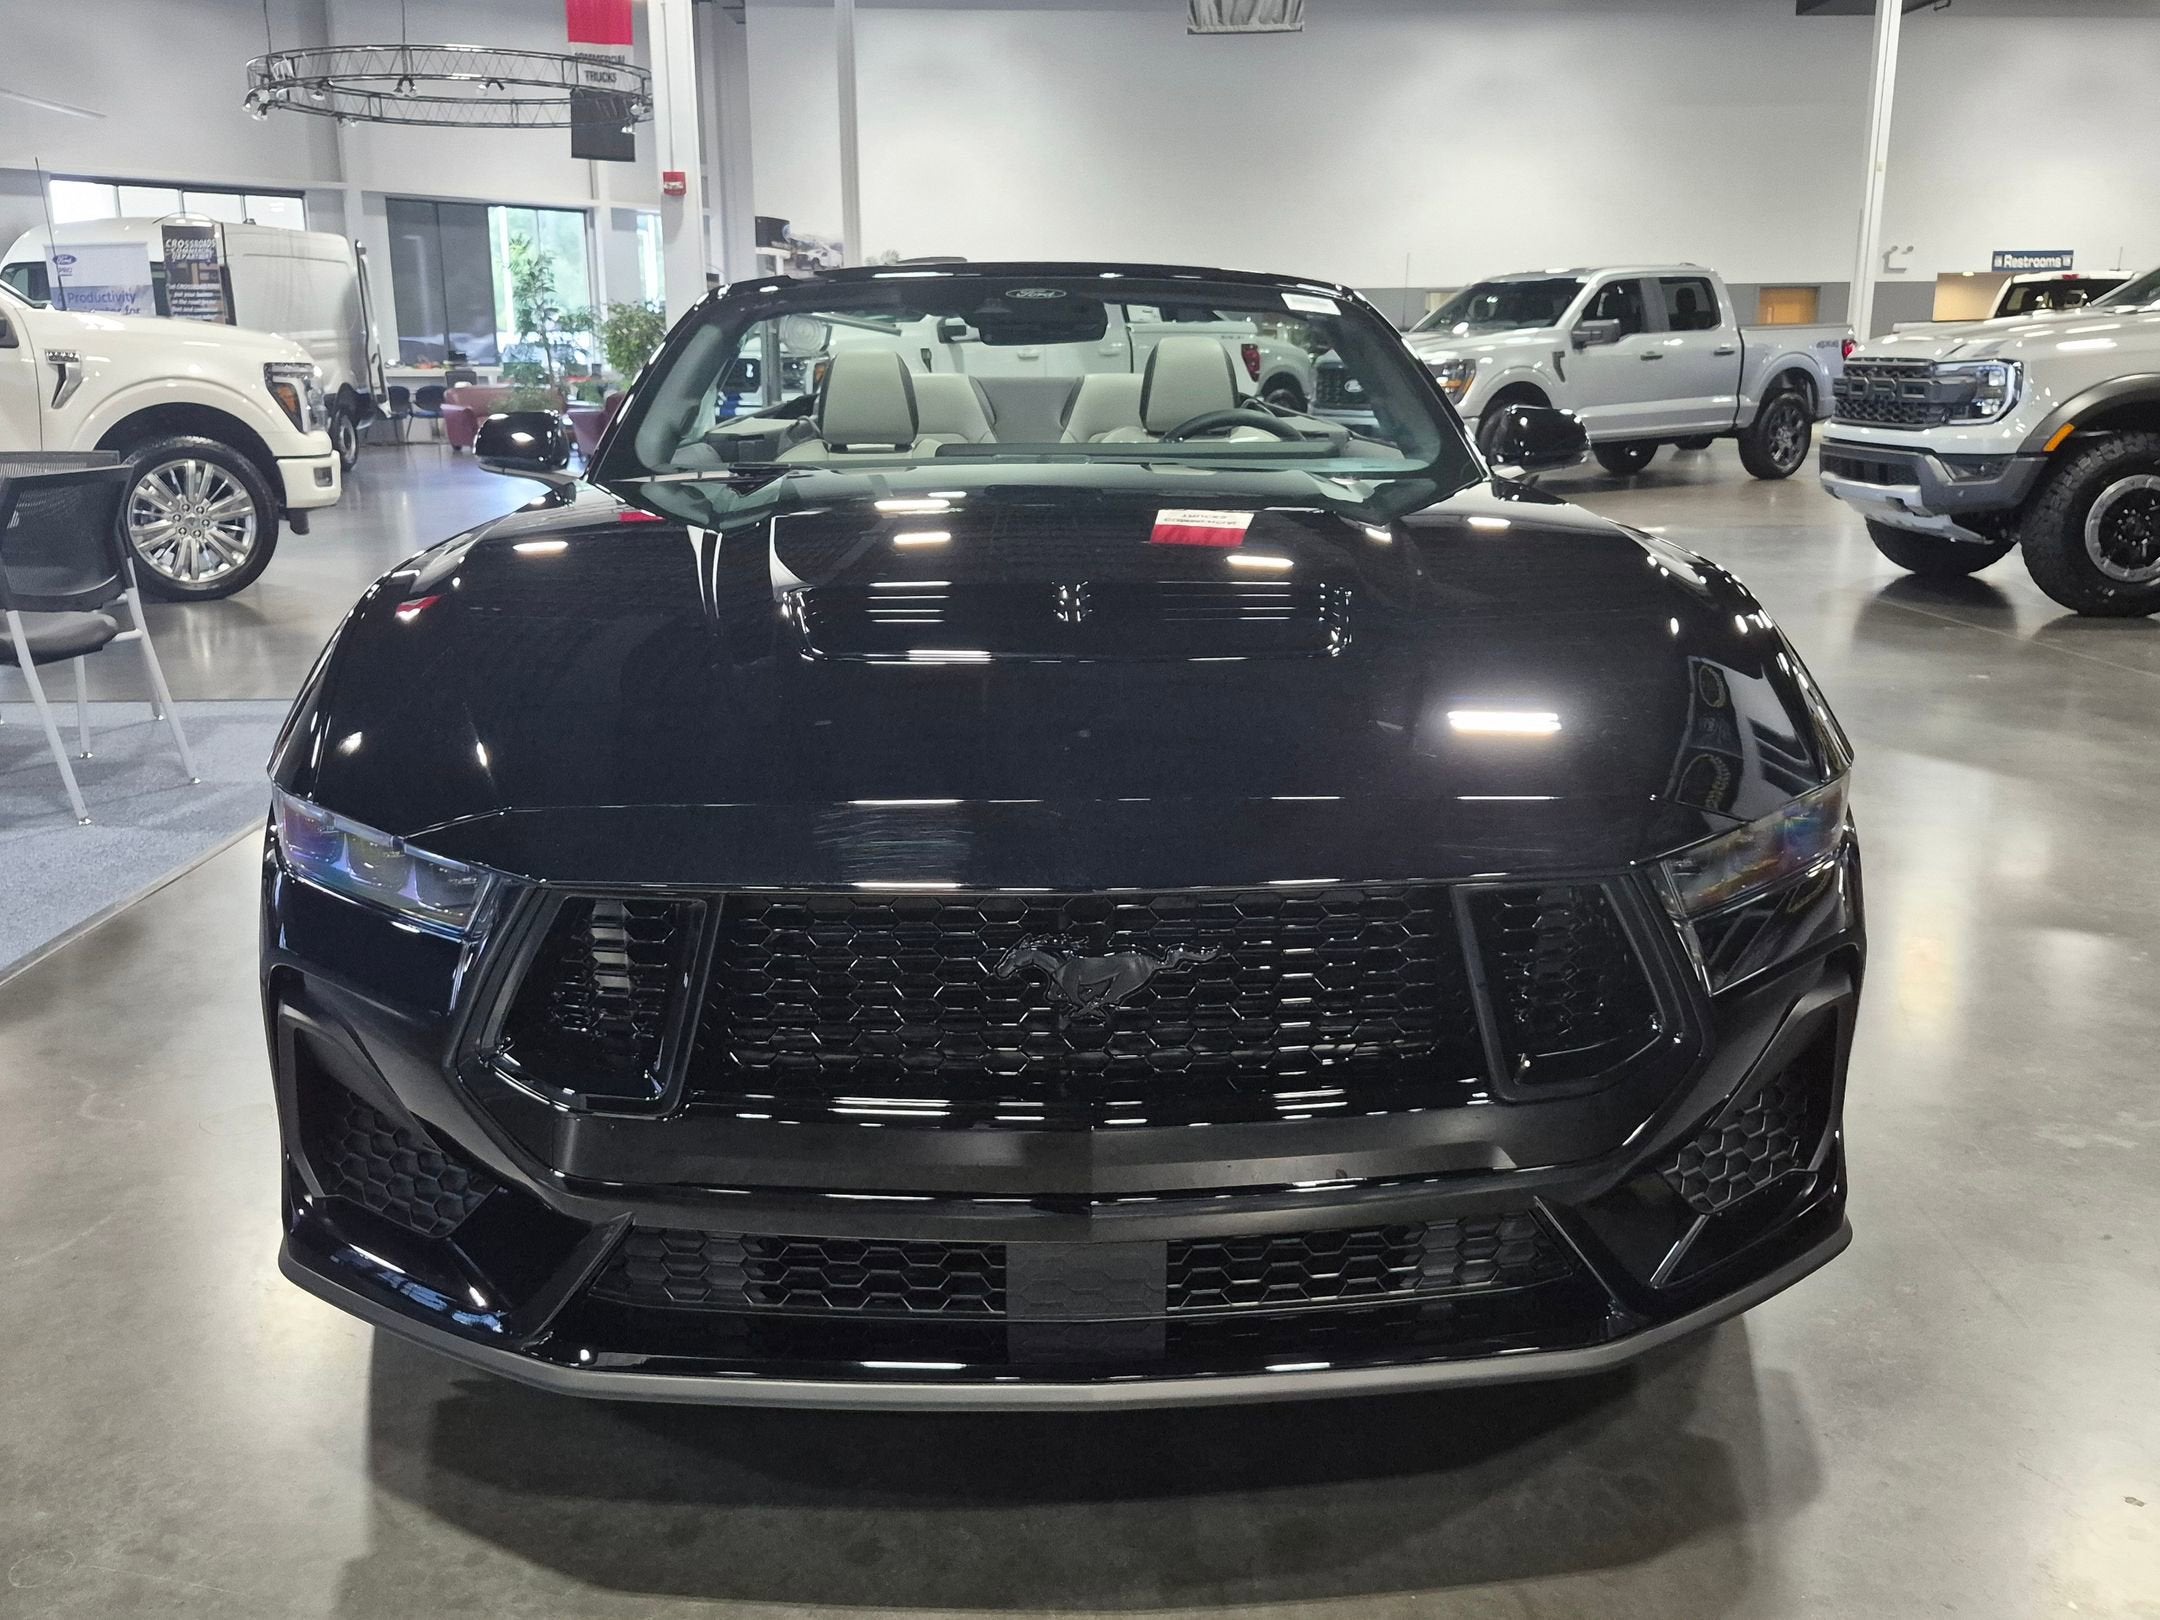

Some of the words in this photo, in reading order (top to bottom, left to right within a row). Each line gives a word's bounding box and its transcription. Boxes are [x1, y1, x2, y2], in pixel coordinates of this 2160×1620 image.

[584, 70, 617, 83] TRUCKS
[2003, 254, 2062, 268] Restrooms
[67, 290, 136, 304] Productivity
[1012, 289, 1059, 299] Ford
